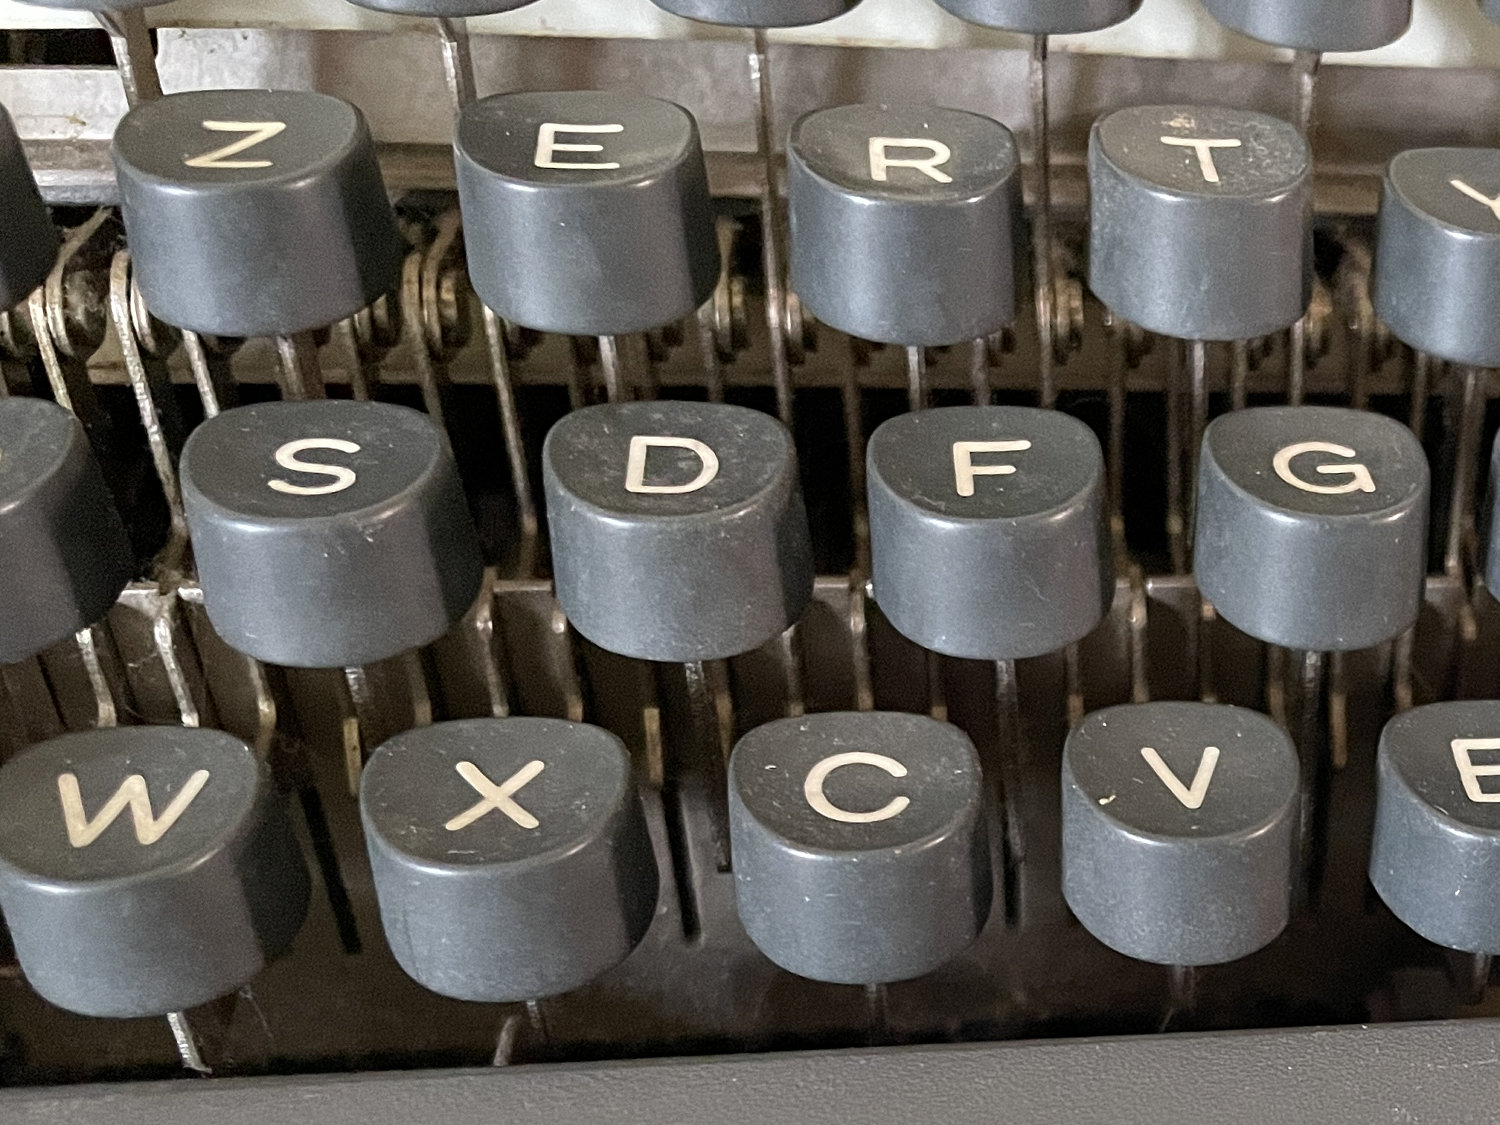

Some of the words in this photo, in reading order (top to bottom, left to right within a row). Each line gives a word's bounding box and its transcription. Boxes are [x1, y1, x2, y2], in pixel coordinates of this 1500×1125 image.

[184, 120, 287, 169] Z
[534, 122, 625, 170] E
[868, 136, 953, 183] R
[1160, 135, 1242, 185] T
[267, 437, 361, 496] S
[625, 435, 719, 494] D
[952, 439, 1032, 497] F
[1272, 441, 1376, 495] G
[444, 759, 545, 831] X
[803, 751, 911, 823] C
[1140, 746, 1221, 809] V
[57, 769, 210, 848] W
